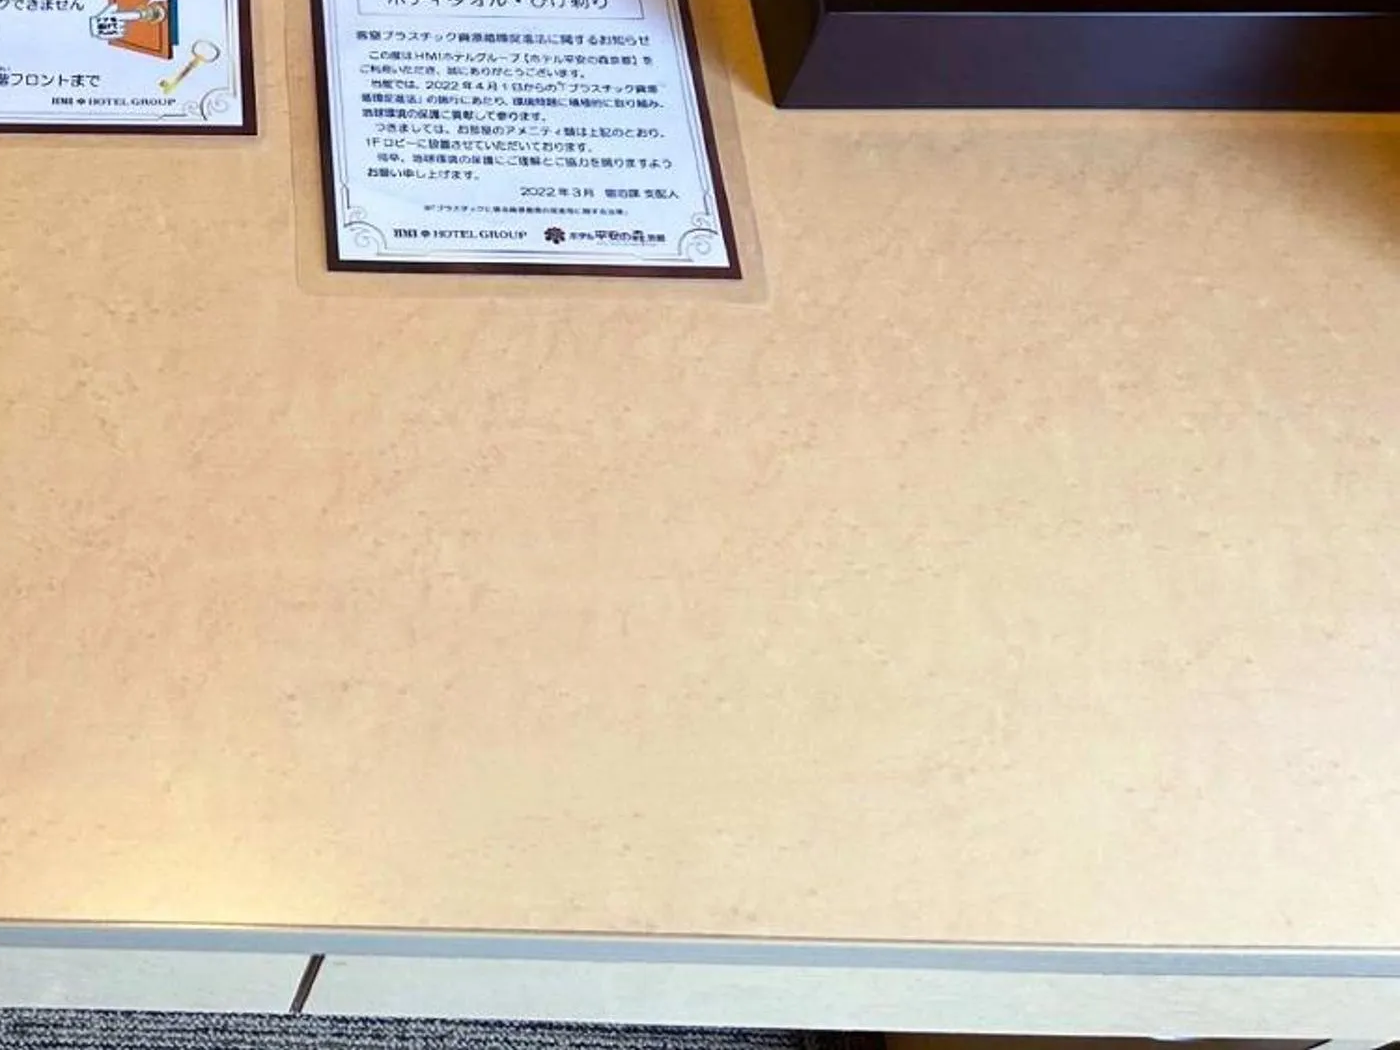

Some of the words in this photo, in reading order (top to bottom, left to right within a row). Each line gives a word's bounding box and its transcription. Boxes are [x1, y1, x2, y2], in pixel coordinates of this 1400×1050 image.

[88, 97, 129, 106] HOTEL
[131, 97, 177, 106] GROUP
[433, 229, 477, 240] HOTEL
[479, 229, 527, 240] GROUP
